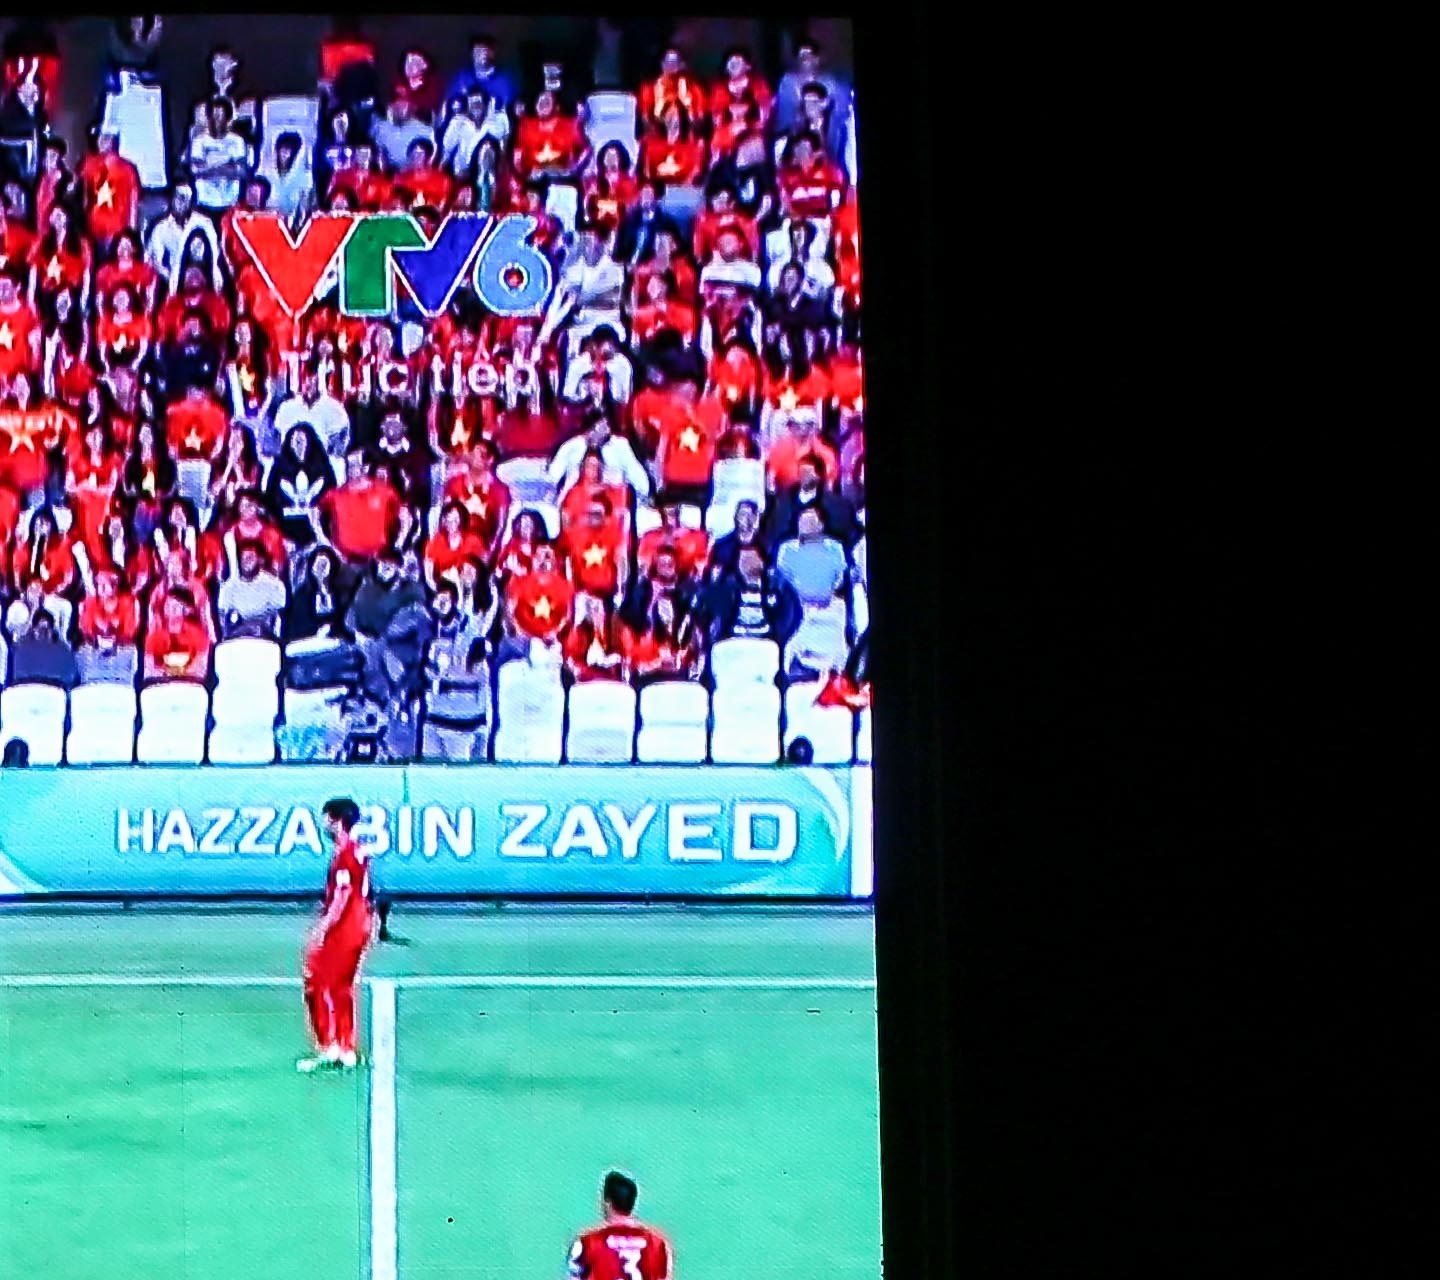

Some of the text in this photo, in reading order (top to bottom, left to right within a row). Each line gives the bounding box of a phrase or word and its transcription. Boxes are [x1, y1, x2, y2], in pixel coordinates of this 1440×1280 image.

[232, 210, 552, 318] VTV6
[116, 805, 328, 857] HAZZA
[500, 802, 802, 864] ZAYED
